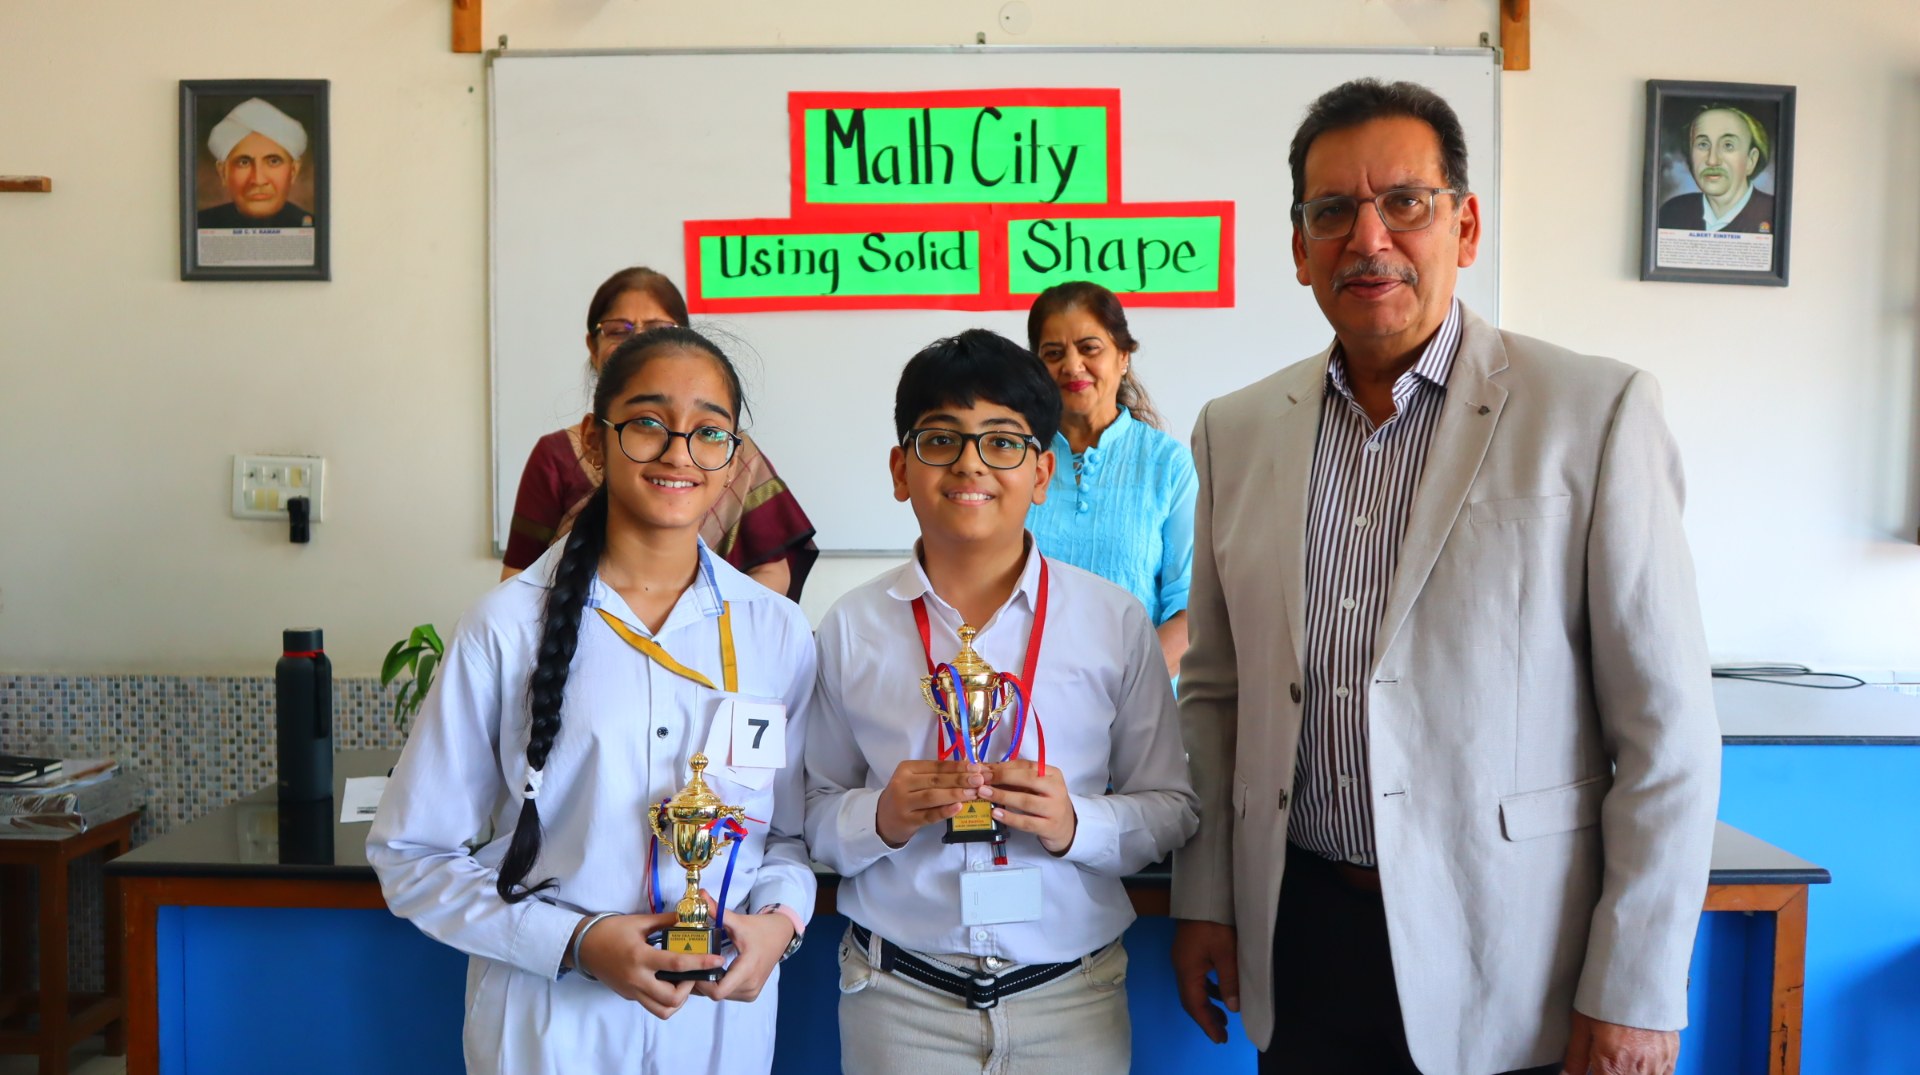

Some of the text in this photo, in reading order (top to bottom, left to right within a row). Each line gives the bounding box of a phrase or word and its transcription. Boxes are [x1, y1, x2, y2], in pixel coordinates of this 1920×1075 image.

[821, 106, 1086, 204] Math City
[719, 219, 1207, 295] Using Solid Shape
[748, 718, 769, 749] 7
